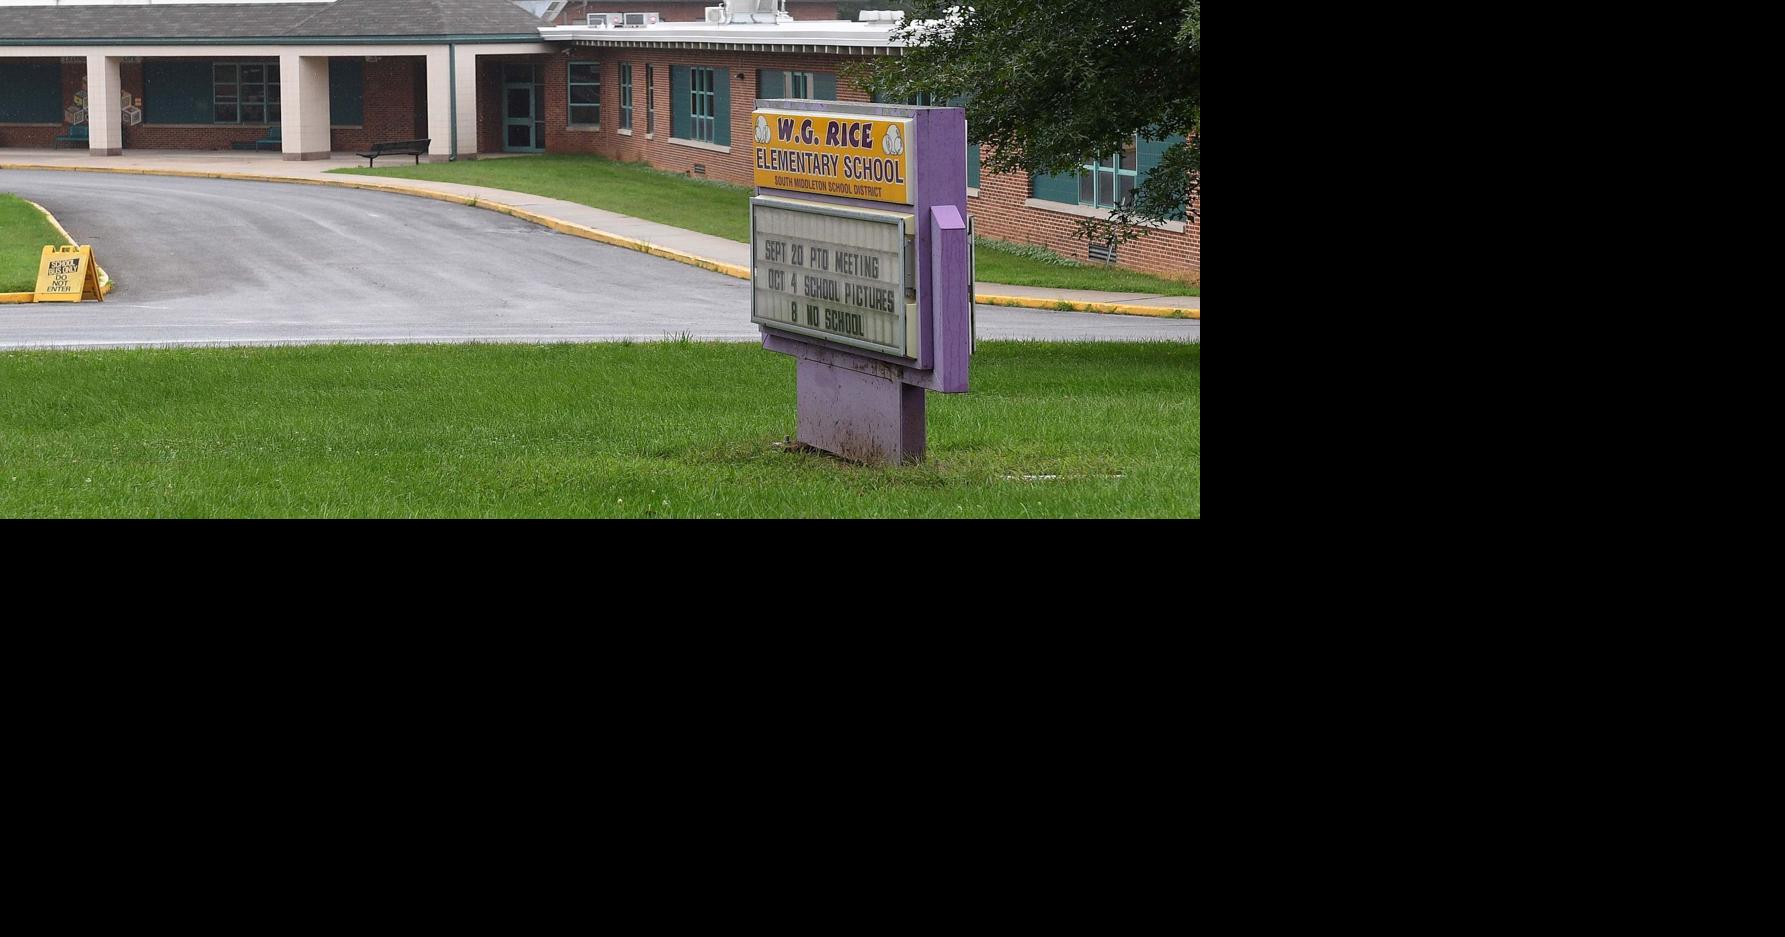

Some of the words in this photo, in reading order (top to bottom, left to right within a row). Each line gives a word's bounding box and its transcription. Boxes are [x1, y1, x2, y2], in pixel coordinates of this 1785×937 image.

[777, 118, 819, 145] W.G.
[826, 120, 873, 148] RICE
[756, 148, 838, 176] ELEMENTARY
[844, 156, 904, 183] SCHOOL
[774, 175, 793, 187] SOUTH
[794, 178, 826, 191] MIDDLETON
[828, 182, 852, 194] SCHOOL
[854, 185, 881, 197] DISTRICT
[765, 240, 785, 263] SEPT
[791, 244, 803, 266] 20
[810, 247, 829, 270] PTO
[835, 251, 879, 279] MEETING
[768, 269, 785, 291] OCT
[791, 273, 797, 293] 4
[804, 276, 840, 302] SCHOOL
[845, 283, 895, 312] PICTURES
[791, 302, 797, 322] 8
[807, 304, 819, 327] NO
[825, 309, 864, 336] SCHOOL
